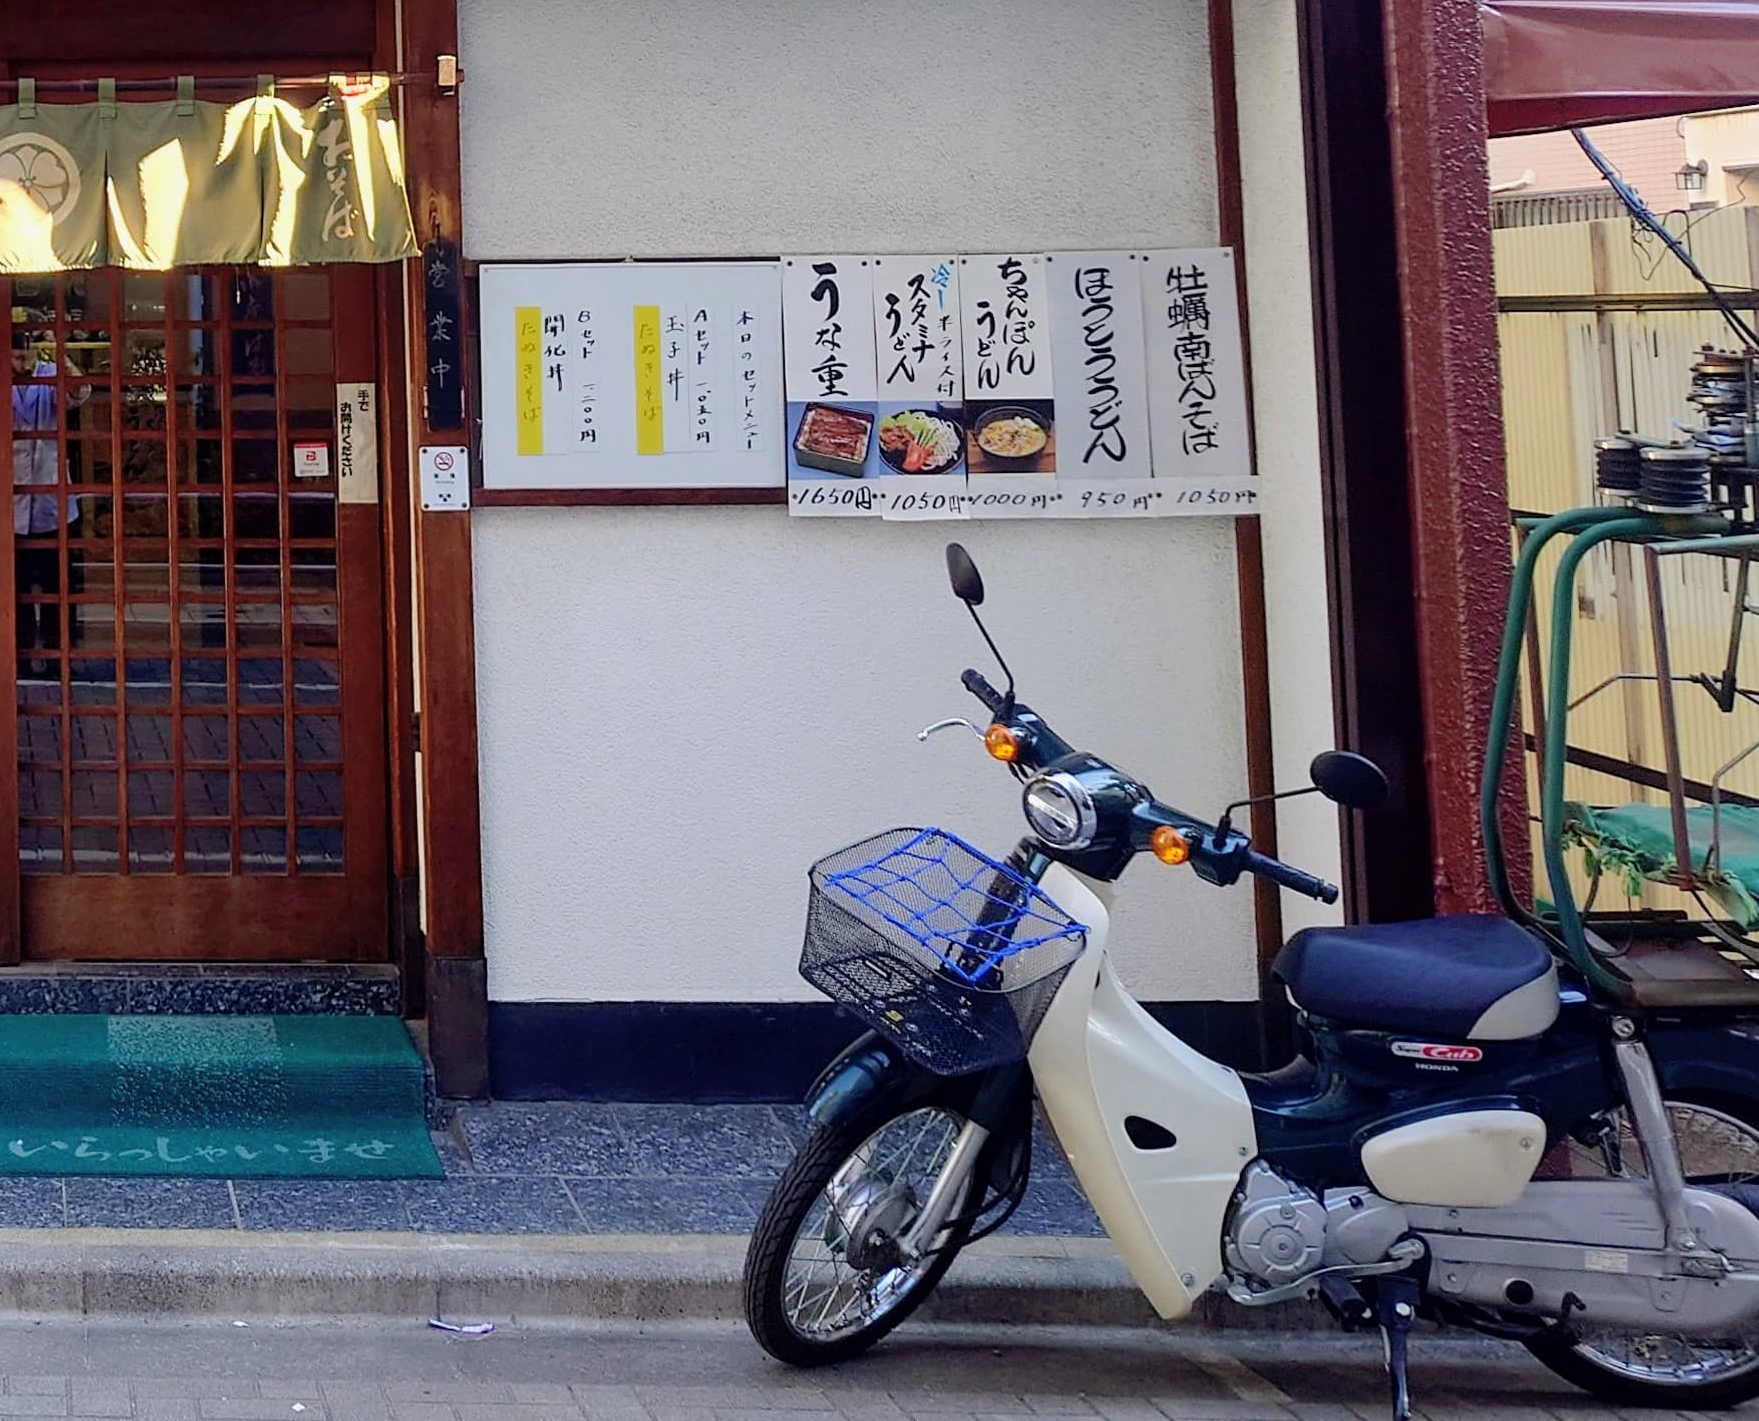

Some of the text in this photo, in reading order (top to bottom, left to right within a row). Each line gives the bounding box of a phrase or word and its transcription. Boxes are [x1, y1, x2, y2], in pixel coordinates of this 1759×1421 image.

[428, 260, 454, 388] 営業中
[811, 262, 848, 397] うな重
[884, 293, 915, 384] うどん
[908, 274, 935, 364] スタミナ
[976, 301, 1000, 390] うどん
[997, 257, 1035, 376] ちゃんぽん
[357, 389, 370, 412] 手で
[521, 323, 542, 422] たぬきそば
[640, 325, 663, 422] たぬきそば
[736, 310, 759, 450] 本日のセットメニュー
[1075, 267, 1126, 464] ほうとううどん
[340, 402, 353, 478] お開けください
[797, 486, 873, 510] 1650円
[890, 493, 962, 514] 1050円
[1081, 490, 1149, 510] 950円
[1415, 1062, 1460, 1073] HONDA
[1429, 1047, 1475, 1059] Cub
[8, 1135, 395, 1163] いらっしゃいませ
